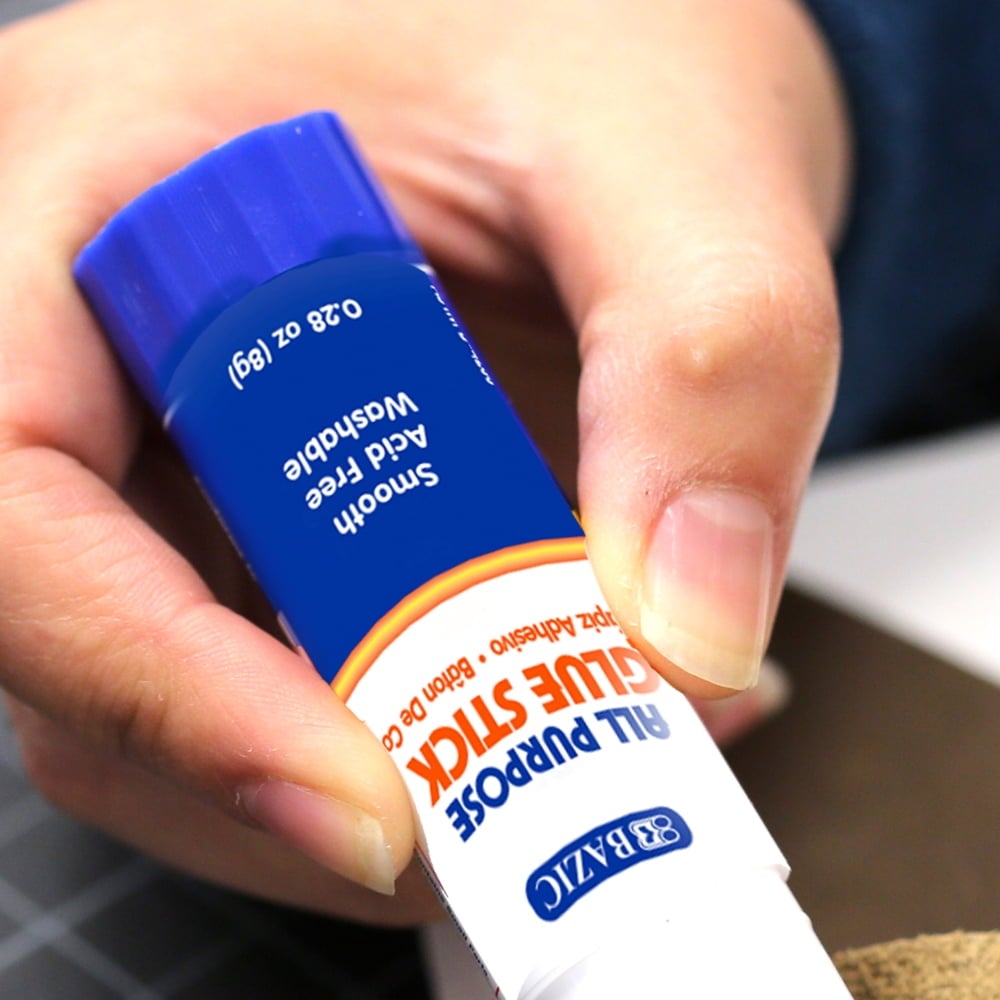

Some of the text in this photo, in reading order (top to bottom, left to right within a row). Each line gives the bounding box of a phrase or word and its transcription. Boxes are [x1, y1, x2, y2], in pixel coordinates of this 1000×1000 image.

[227, 298, 363, 391] 0.28 oz (8g)
[283, 391, 420, 481] Washable
[305, 424, 428, 510] Acid Free
[333, 462, 440, 535] Smooth
[382, 604, 623, 752] piz Adhesivo Bâton De Co
[405, 646, 661, 808] GLUE STICK
[444, 703, 671, 843] ALL PURPOSE
[535, 826, 638, 912] BAZIC
